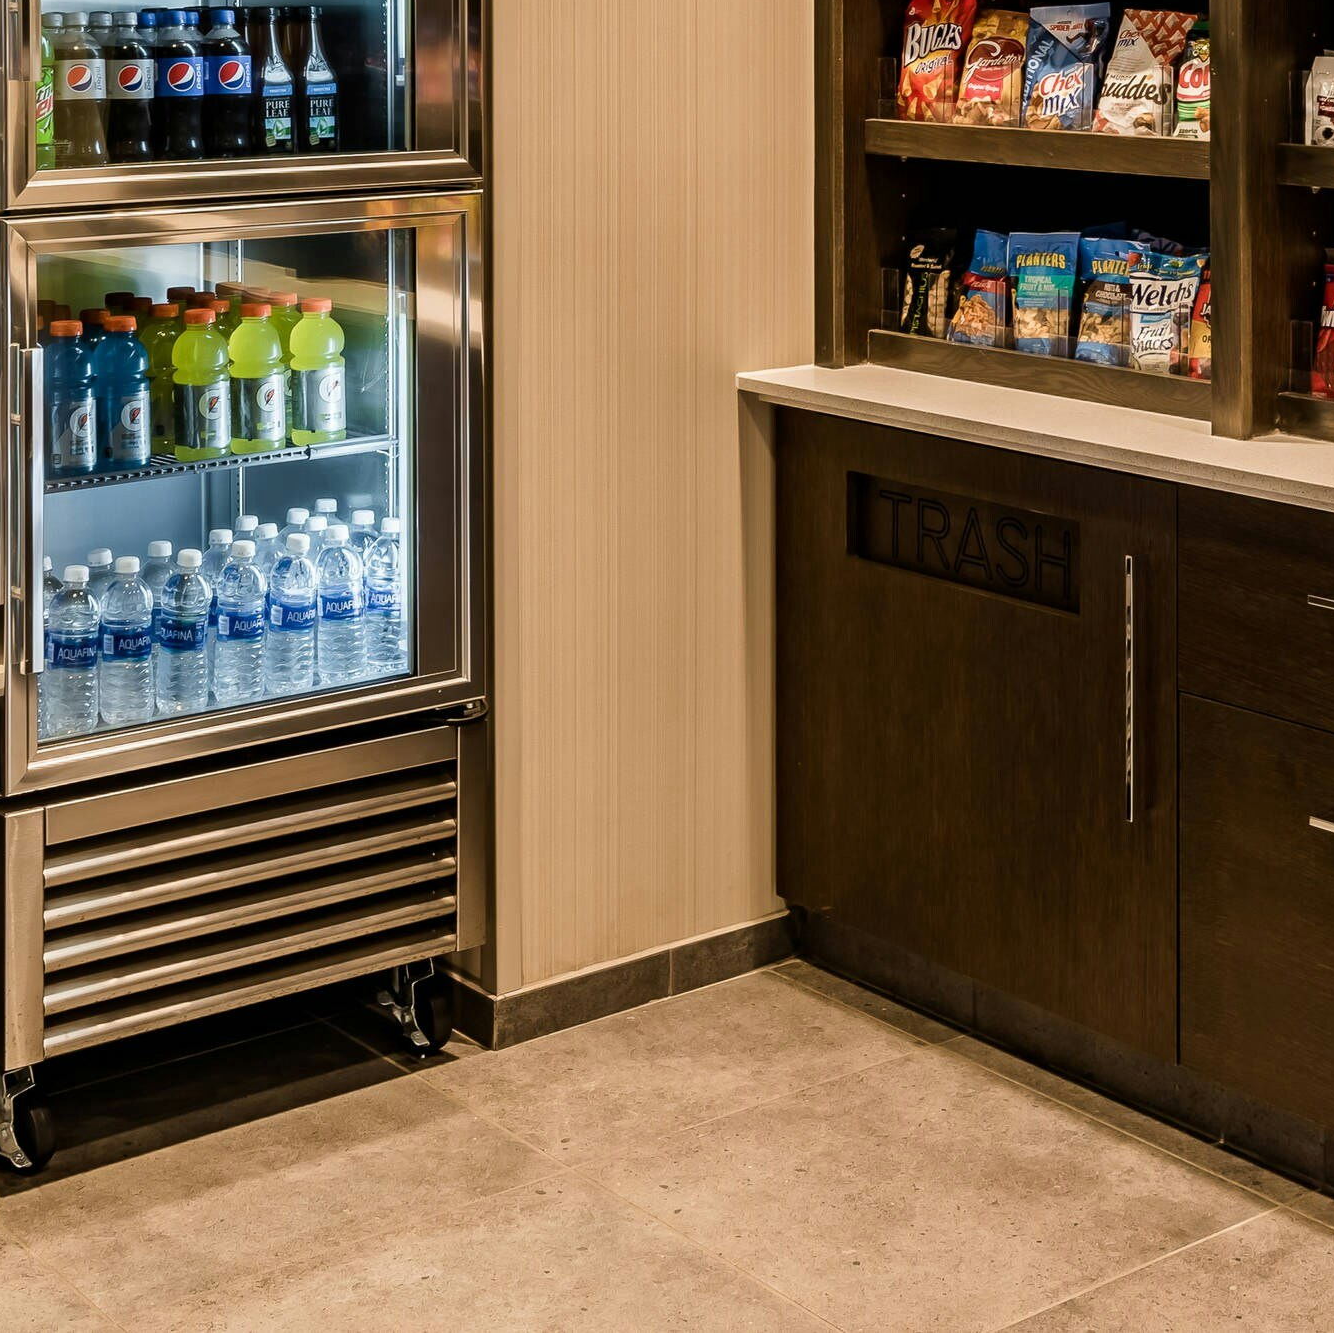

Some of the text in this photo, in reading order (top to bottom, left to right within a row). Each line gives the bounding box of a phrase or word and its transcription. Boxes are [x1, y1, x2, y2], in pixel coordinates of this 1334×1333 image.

[1119, 29, 1140, 39] Chex
[904, 22, 963, 68] BUGLES
[1039, 68, 1083, 96] Chex
[266, 100, 290, 109] PURE
[310, 99, 334, 108] PURE
[266, 108, 290, 118] LEAF
[1016, 251, 1066, 269] PLANTERS
[1130, 282, 1194, 307] Welch's
[879, 490, 1071, 601] TRASH
[160, 628, 193, 642] QUAFINA
